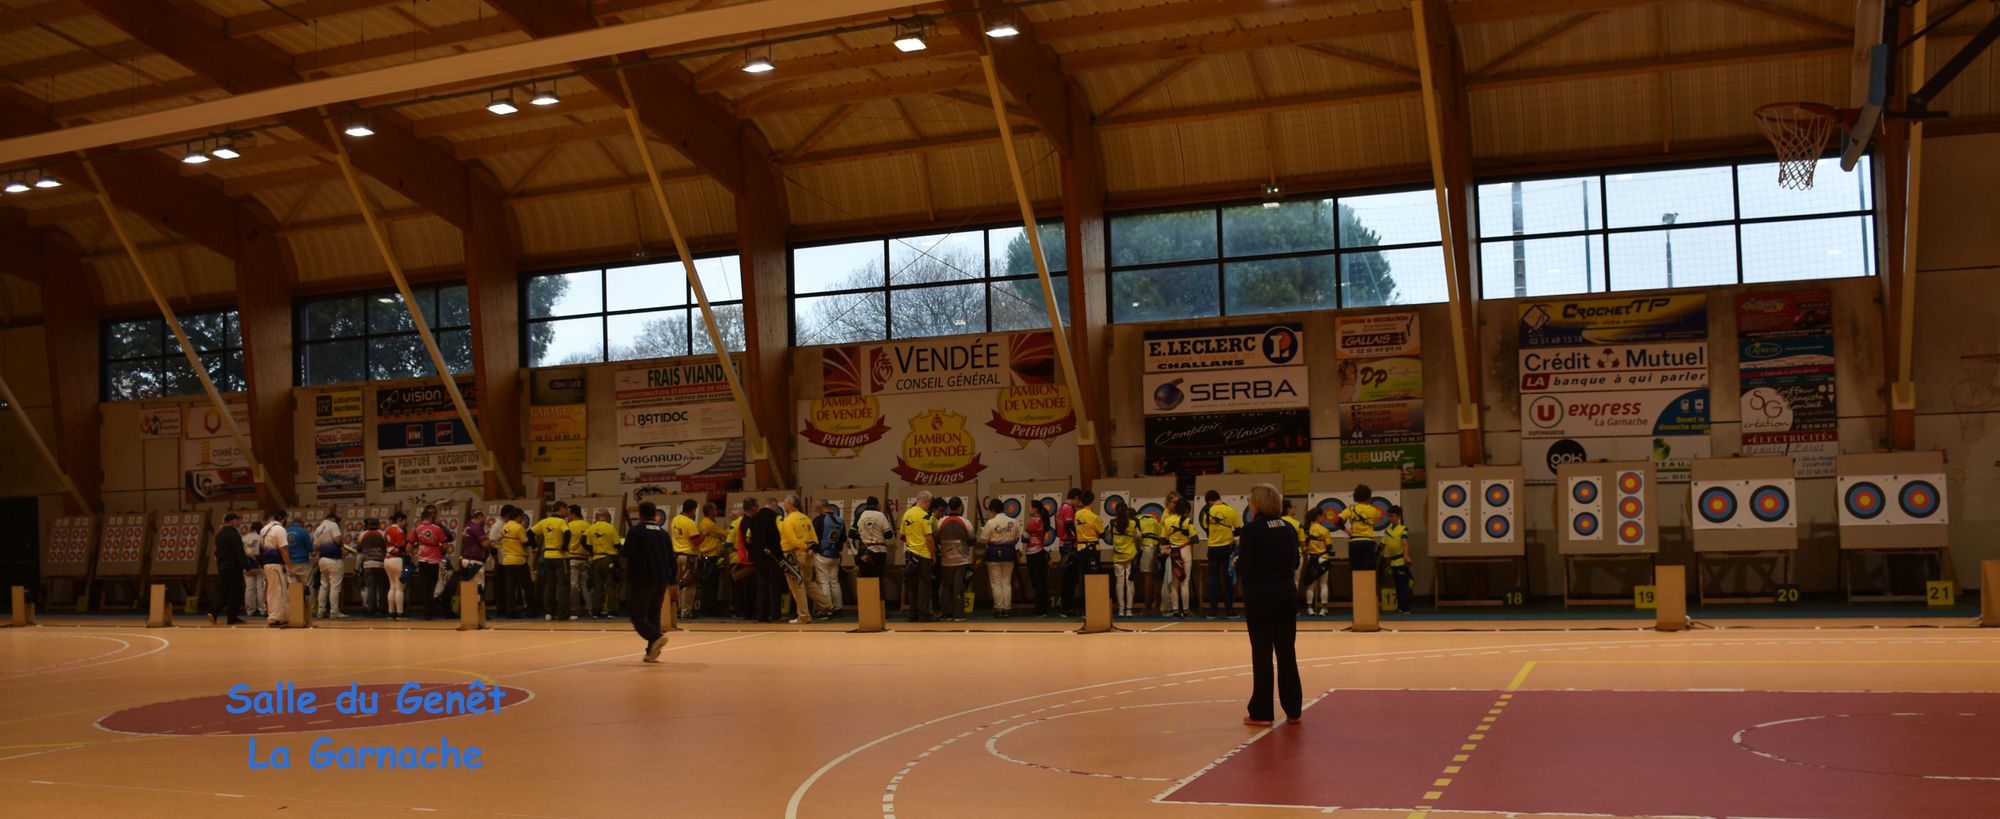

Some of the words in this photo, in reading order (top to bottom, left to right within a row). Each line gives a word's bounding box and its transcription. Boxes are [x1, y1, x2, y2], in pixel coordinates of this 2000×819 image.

[1149, 336, 1256, 357] E.LECLERC
[1345, 334, 1391, 346] GALLAIS
[894, 338, 999, 373] VENDÉE
[1525, 352, 1591, 371] Crédit
[1626, 347, 1703, 368] Mutuel
[1157, 359, 1244, 370] CHALLANS
[647, 367, 681, 388] FRAIS
[683, 362, 738, 384] VIAND
[896, 377, 943, 391] CONSEIL
[947, 373, 1001, 388] GÉNÉRAL
[1526, 376, 1545, 387] LA
[1553, 374, 1606, 386] banque
[1614, 374, 1622, 384] à
[1629, 373, 1653, 386] qui
[1660, 371, 1706, 383] parler
[402, 387, 442, 403] vision
[1009, 384, 1059, 396] JAMBON
[1190, 379, 1298, 401] SERBA
[821, 396, 867, 408] JAMBON
[1004, 399, 1018, 411] DE
[1020, 396, 1067, 410] VENDÉE
[530, 406, 567, 417] GARAGE
[816, 409, 830, 420] DE
[832, 406, 873, 419] VENDÉE
[1537, 405, 1555, 421] U
[1568, 402, 1642, 420] express
[1594, 417, 1605, 426] La
[1607, 417, 1648, 426] Garnache
[1010, 422, 1062, 439] Petitgas
[1352, 431, 1363, 439] 44
[821, 432, 870, 448] Petitgas
[914, 432, 962, 446] JAMBON
[908, 447, 922, 458] DE
[924, 443, 969, 457] VENDÉE
[1344, 450, 1404, 464] SUBWAY
[399, 456, 430, 467] PEINTURE
[622, 453, 683, 464] VRIGNAUD
[914, 470, 965, 484] Petitgas
[1385, 593, 1398, 604] 17
[1505, 591, 1522, 605] 18
[1638, 591, 1655, 603] 19
[1777, 588, 1799, 602] 20
[1929, 586, 1950, 600] 21
